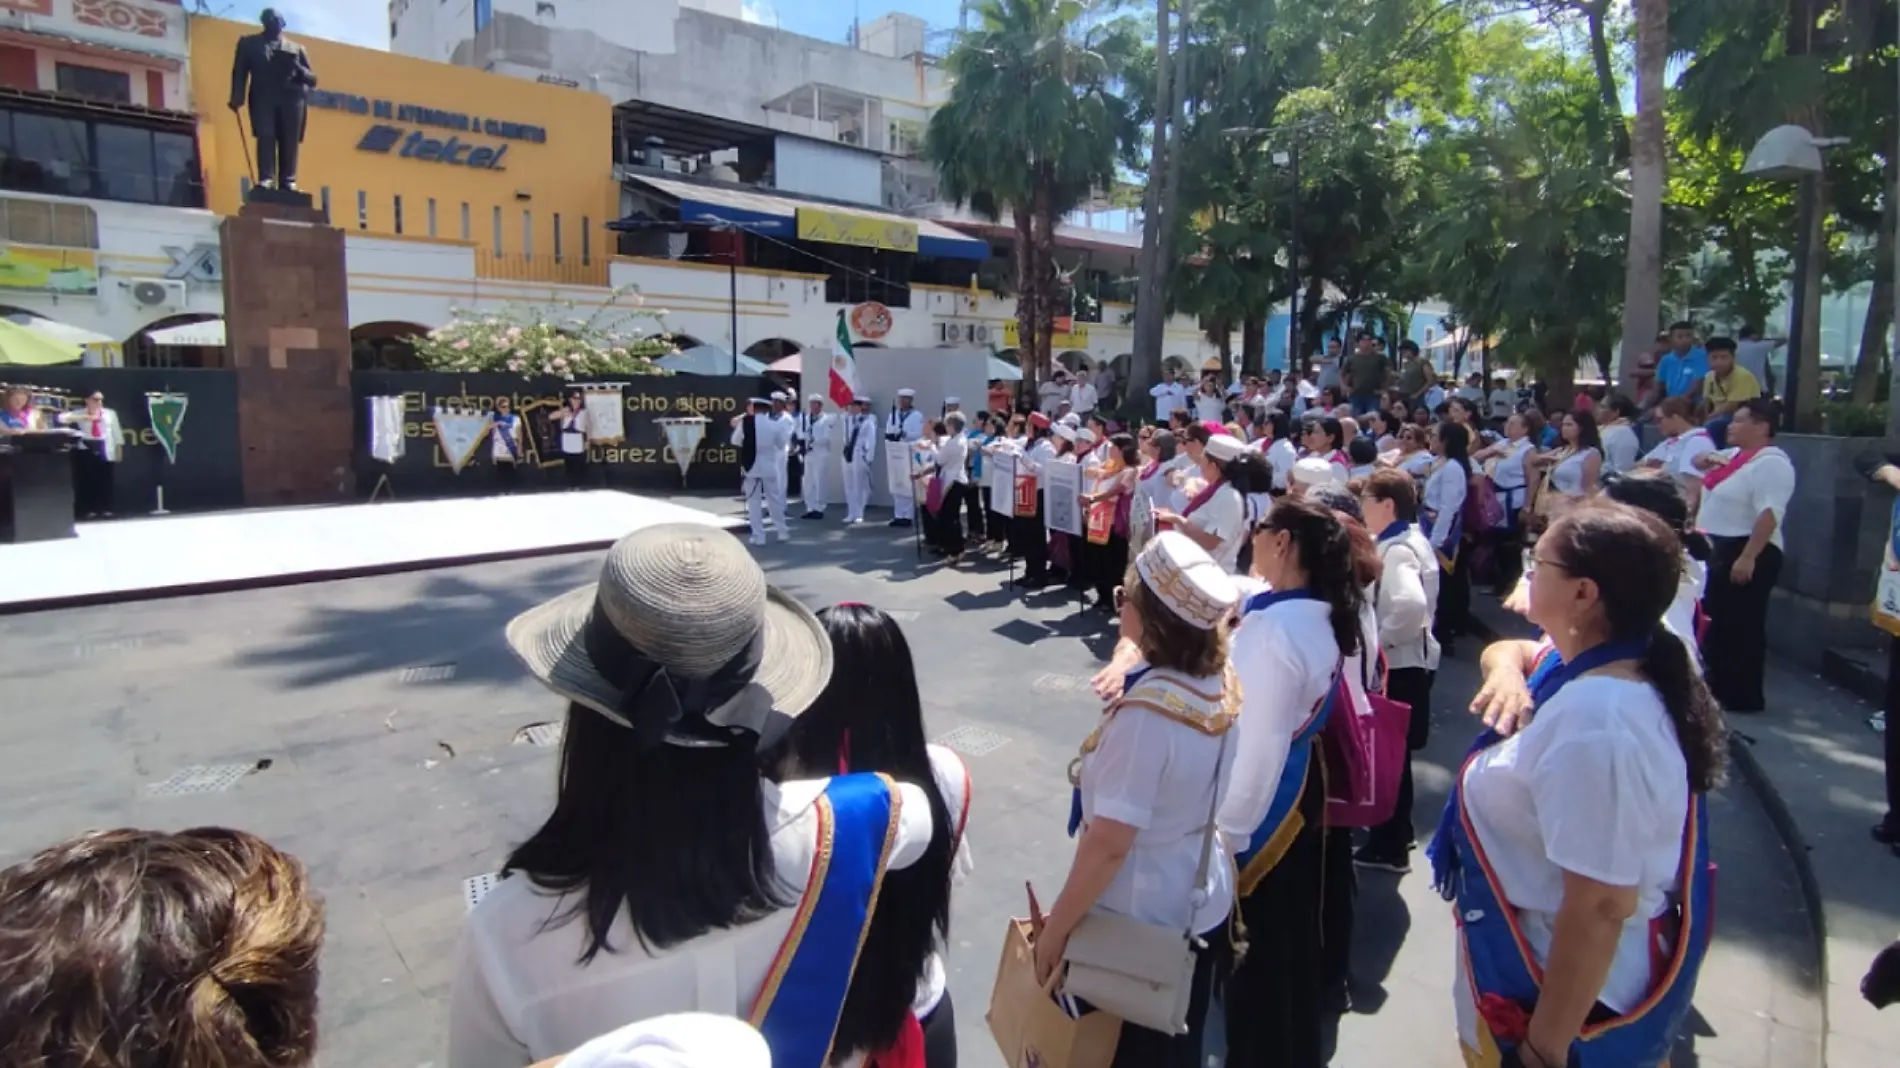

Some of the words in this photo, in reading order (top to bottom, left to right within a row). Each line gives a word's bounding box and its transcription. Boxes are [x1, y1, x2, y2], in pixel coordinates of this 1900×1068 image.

[373, 99, 393, 119] DE
[471, 116, 482, 133] A
[399, 130, 508, 172] telcel
[403, 391, 427, 412] El
[403, 421, 437, 438] es
